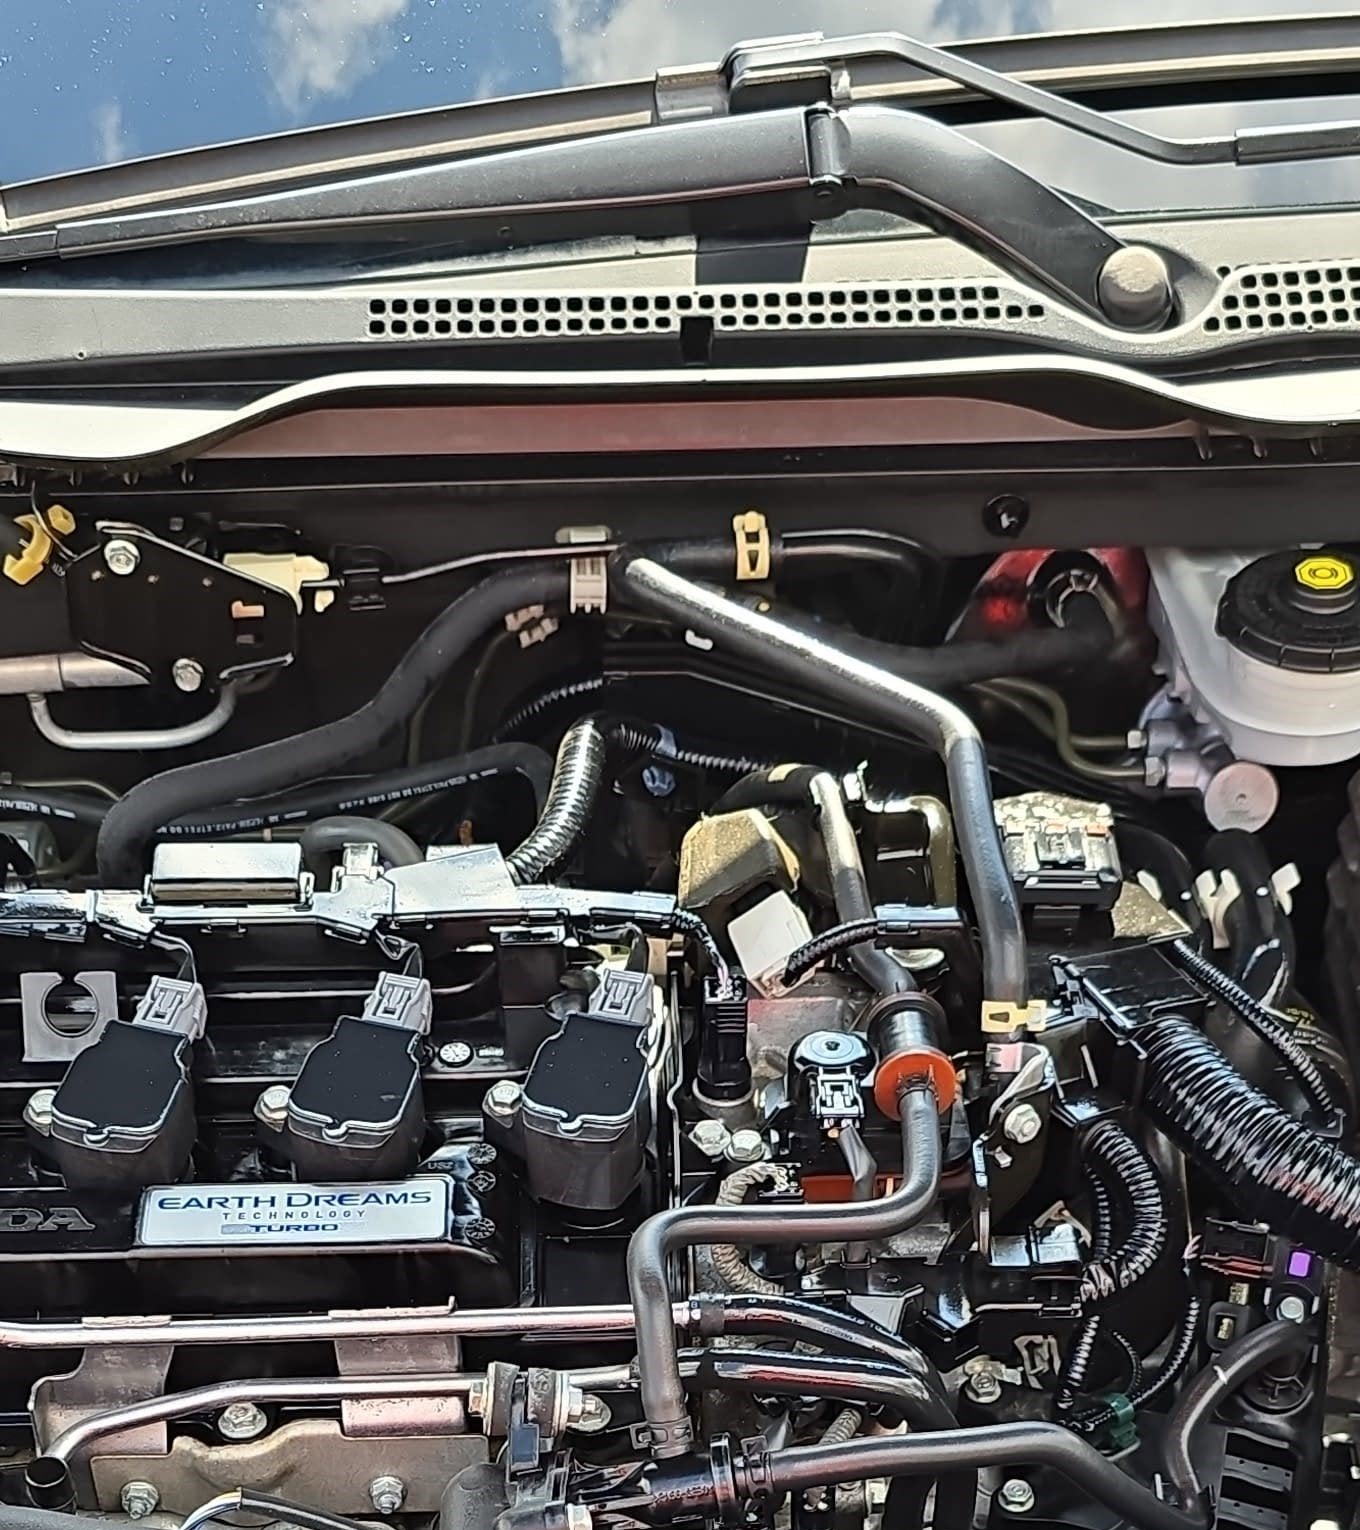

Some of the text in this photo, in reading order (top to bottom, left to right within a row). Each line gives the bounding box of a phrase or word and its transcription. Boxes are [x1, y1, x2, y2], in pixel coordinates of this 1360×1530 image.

[158, 1191, 432, 1210] EARTH DREAMS
[222, 1210, 367, 1221] TECHNOLOGY
[250, 1223, 339, 1233] TURBO
